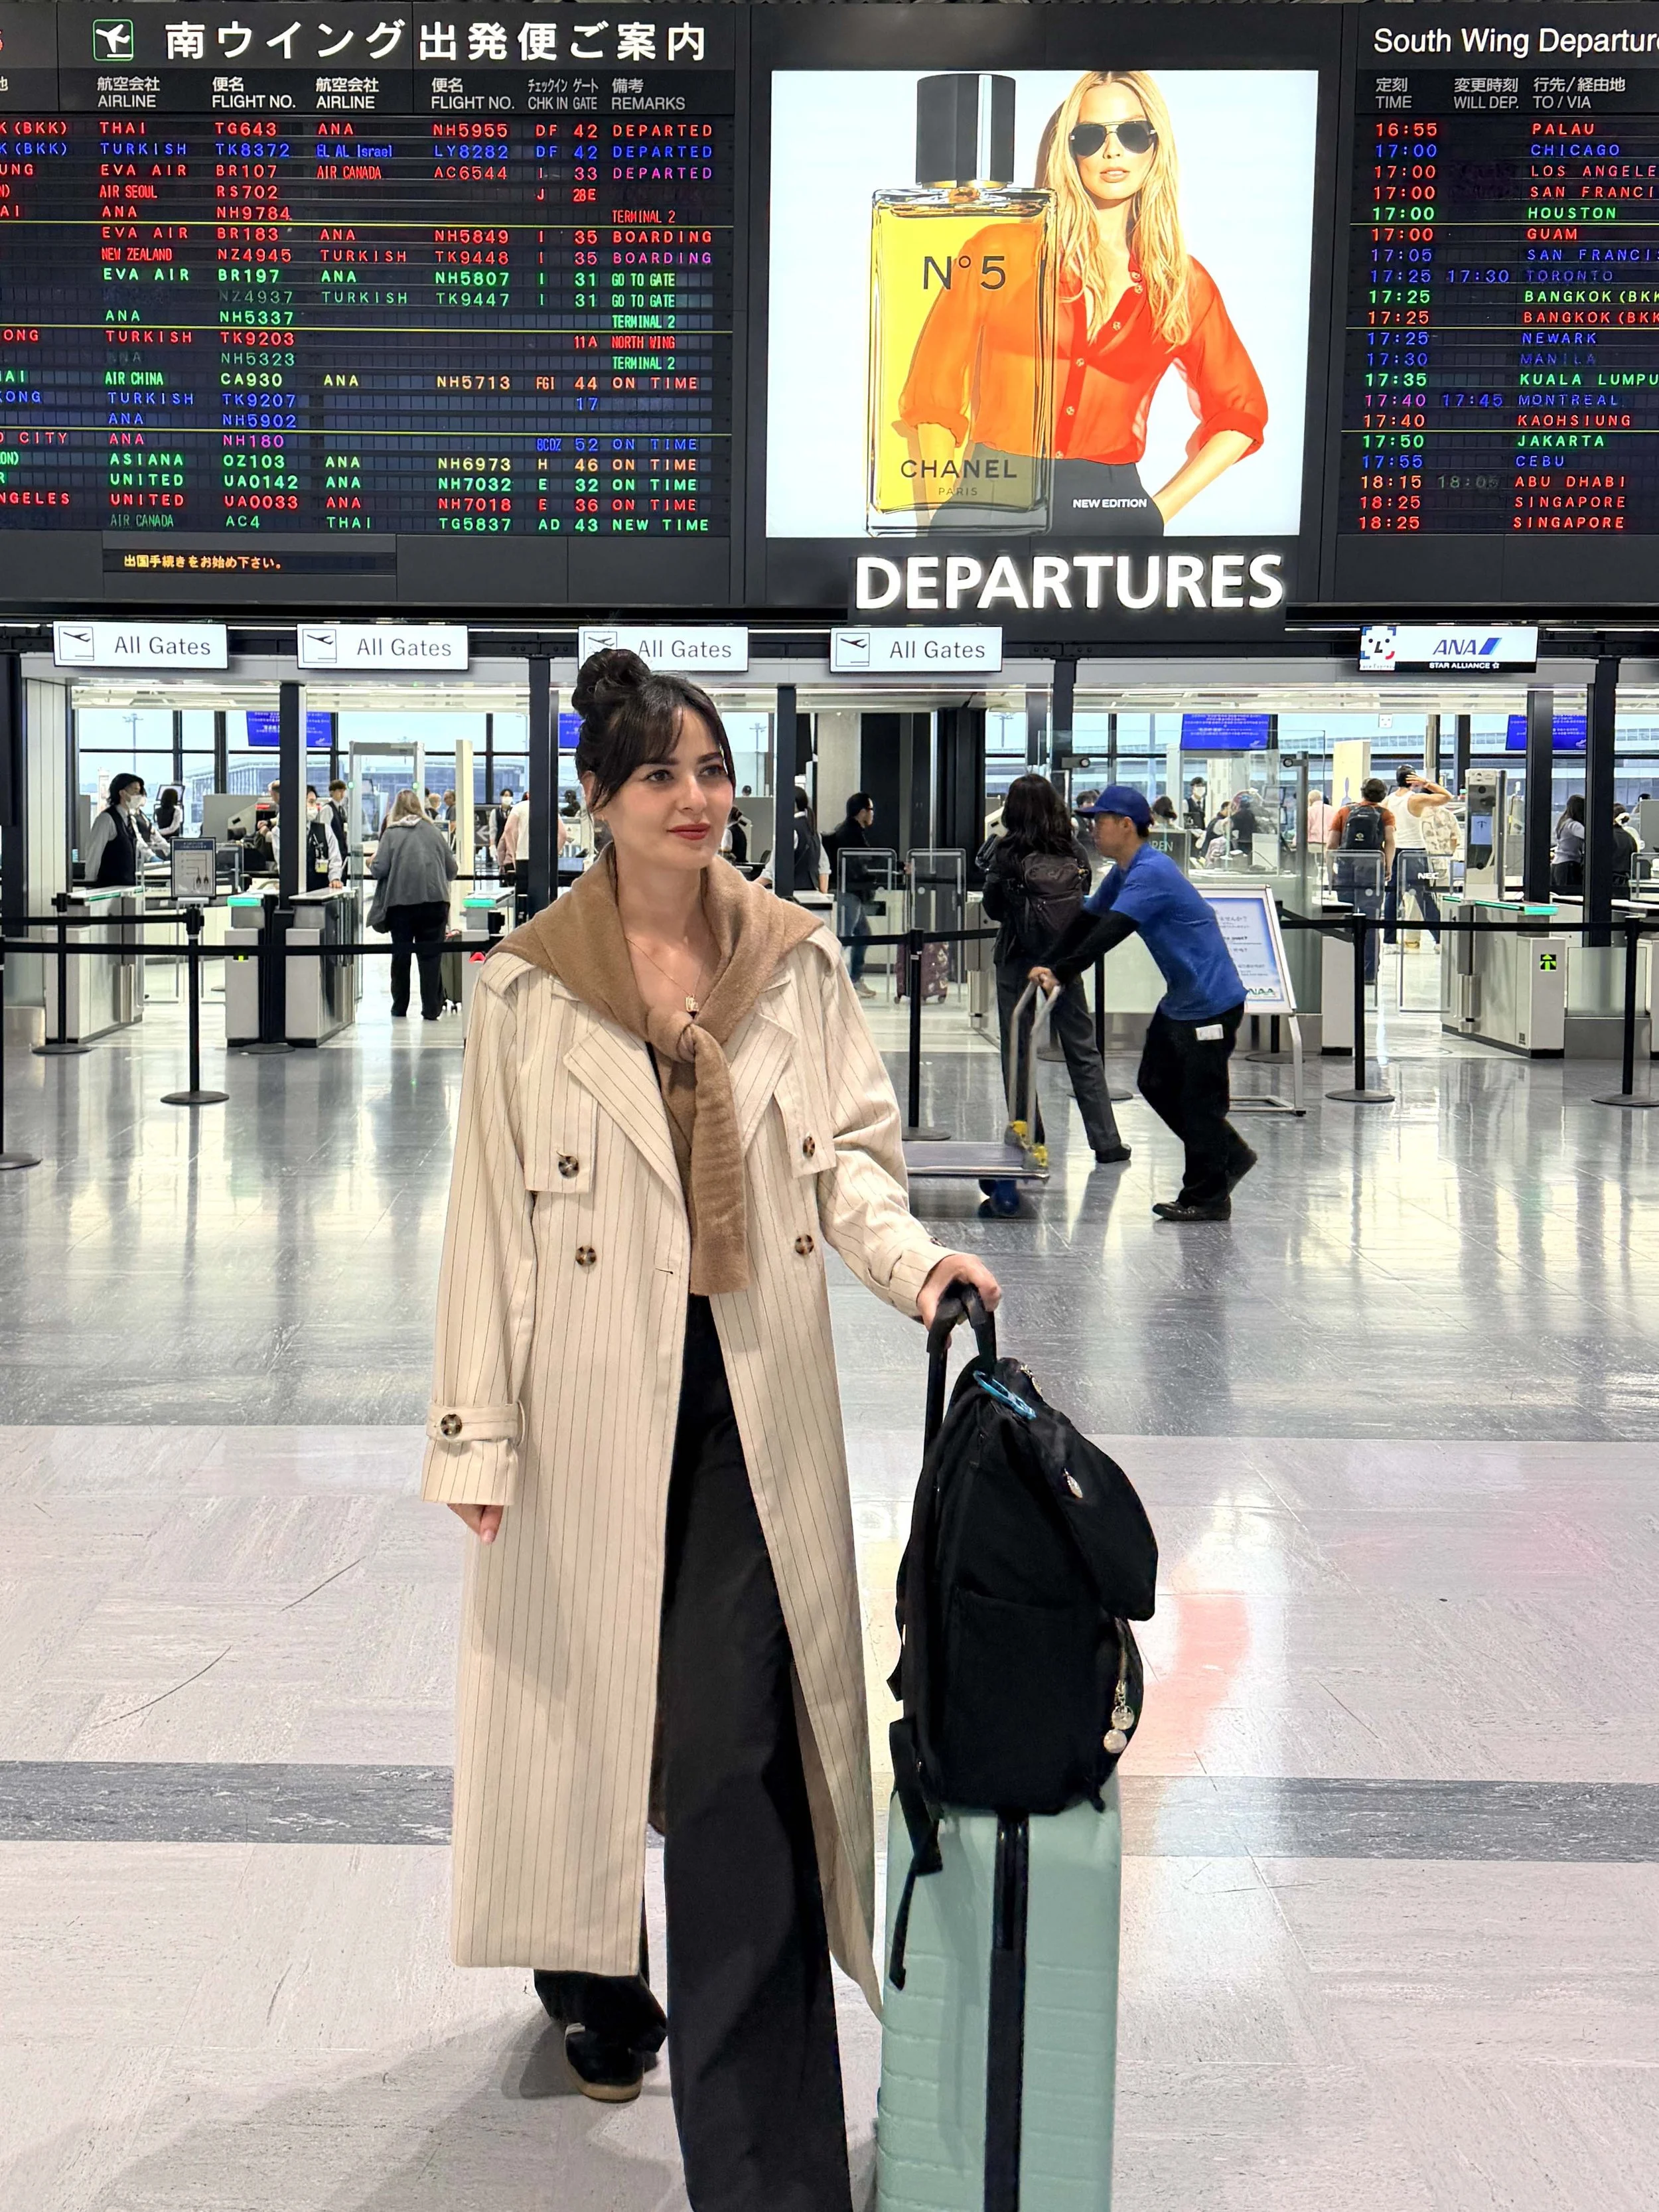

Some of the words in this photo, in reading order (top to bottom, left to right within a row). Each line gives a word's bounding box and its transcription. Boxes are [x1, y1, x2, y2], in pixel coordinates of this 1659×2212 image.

[166, 19, 704, 60] 南ウイング出発便ご案内
[1374, 29, 1451, 52] South
[1461, 29, 1529, 58] Wing
[1540, 29, 1659, 58] Departur
[98, 76, 160, 91] 航空会社
[213, 76, 244, 92] 便名
[316, 77, 379, 92] 航空会社
[432, 78, 463, 92] 便名
[528, 78, 567, 92] チェックイン
[573, 78, 598, 93] ゲート
[613, 78, 644, 93] 備考
[1376, 77, 1407, 92] 定刻
[1455, 78, 1518, 92] 変更時刻
[98, 95, 156, 107] AIRLINE
[212, 95, 265, 108] FLIGHT
[270, 95, 295, 108] NO.
[317, 96, 374, 108] AIRLINE
[432, 96, 484, 109] FLIGHT
[489, 96, 514, 109] NO.
[528, 97, 553, 110] CHK
[557, 97, 567, 109] IN
[573, 97, 597, 110] GATE
[612, 97, 685, 110] REMARKS
[1376, 96, 1411, 108] TIME
[1454, 96, 1486, 108] WILL
[1490, 96, 1519, 108] DEP.
[1533, 96, 1553, 108] TO
[1567, 96, 1591, 108] VIA
[15, 122, 66, 134] (BKK)
[100, 122, 144, 133] THAI
[215, 123, 276, 136] TG643
[319, 123, 353, 135] ANA
[433, 123, 507, 137] NH5955
[613, 125, 711, 136] DEPARTED
[1376, 123, 1437, 136] 16:55
[1533, 123, 1593, 135] PALAU
[101, 143, 185, 155] TURKISH
[216, 143, 289, 157] TK8372
[317, 144, 329, 157] EL
[336, 145, 349, 157] AL
[358, 145, 392, 157] Israel
[435, 145, 508, 159] LY8282
[1376, 144, 1437, 157] 17:00
[1532, 145, 1619, 155] CHICAGO
[101, 165, 135, 175] EVA
[153, 165, 185, 175] AIR
[216, 165, 276, 178] BR107
[316, 166, 336, 179] AIR
[343, 166, 381, 179] CANADA
[435, 167, 506, 180] AC6544
[1532, 165, 1565, 177] LOS
[1583, 166, 1656, 177] ANGELE
[100, 185, 119, 198] AIR
[125, 185, 157, 198] SEOUL
[217, 186, 277, 199] RS702
[573, 188, 595, 202] 28E
[217, 206, 290, 220] NH9784
[613, 210, 662, 222] TERMINAL
[669, 210, 675, 223] 2
[1528, 208, 1615, 218] HOUSTON
[218, 228, 277, 241] BR183
[435, 230, 508, 244] NH5849
[613, 231, 711, 243] BOARDING
[1528, 228, 1577, 240] GUAM
[102, 248, 120, 260] NEW
[127, 248, 172, 261] ZEALAND
[218, 249, 291, 262] NZ4945
[435, 251, 508, 265] TK9448
[1372, 249, 1431, 261] 17:05
[1528, 250, 1561, 260] SAN
[219, 269, 279, 283] BR197
[436, 271, 508, 285] NH5807
[612, 273, 624, 286] GO
[631, 273, 644, 286] TO
[650, 273, 674, 286] GATE
[1372, 269, 1431, 283] 17:25
[1449, 270, 1509, 283] 17:30
[1528, 270, 1612, 281] TORONTO
[219, 291, 292, 304] NZ4937
[437, 293, 508, 306] TK9447
[1525, 291, 1611, 302] BANGKOK
[220, 311, 293, 325] NH5337
[221, 332, 293, 345] TK9203
[575, 336, 597, 348] 11A
[612, 336, 644, 348] NORTH
[650, 336, 675, 349] WING
[1522, 332, 1595, 343] NEWARK
[222, 353, 294, 366] NH5323
[1521, 354, 1595, 364] MANILA
[106, 372, 125, 384] AIR
[131, 372, 163, 385] CHINA
[221, 373, 281, 387] CA930
[437, 376, 510, 389] NH5713
[537, 377, 553, 390] FGI
[613, 377, 634, 388] ON
[651, 378, 697, 389] TIME
[1366, 373, 1426, 386] 17:35
[222, 394, 295, 407] TK9207
[1366, 394, 1425, 406] 17:40
[1443, 394, 1502, 407] 17:45
[1519, 394, 1617, 406] MONTREAL
[223, 414, 296, 428] NH5902
[1518, 415, 1630, 426] KAOHSIUNG
[20, 432, 66, 443] CITY
[224, 435, 283, 447] NH180
[1364, 435, 1423, 447] 17:50
[1518, 435, 1603, 446] JAKARTA
[110, 453, 182, 465] ASIANA
[224, 455, 284, 469] OZ103
[439, 458, 510, 471] NH6973
[1363, 455, 1422, 468] 17:55
[1516, 456, 1563, 467] CEBU
[901, 459, 1017, 479] CHANEL
[111, 474, 182, 486] UNITED
[225, 475, 297, 488] UA0142
[439, 478, 510, 491] NH7032
[1362, 476, 1421, 488] 18:15
[1515, 477, 1550, 486] ABU
[1567, 477, 1624, 487] DHABI
[938, 486, 977, 496] PARIS
[225, 495, 297, 509] UA0033
[439, 498, 510, 511] NH7018
[1073, 499, 1100, 508] NEW
[1102, 499, 1147, 508] EDITION
[1361, 496, 1420, 509] 18:25
[1516, 496, 1624, 508] SINGAPORE
[226, 516, 259, 528] AC4
[439, 518, 510, 531] TG5837
[613, 520, 648, 530] NEW
[663, 520, 707, 530] TIME
[856, 555, 1283, 609] DEPARTURES
[115, 636, 139, 653] All
[149, 637, 210, 654] Gates
[358, 638, 382, 655] All
[392, 639, 451, 656] Gates
[639, 640, 662, 657] All
[672, 640, 731, 657] Gates
[890, 641, 914, 658] All
[924, 641, 984, 658] Gates
[1433, 640, 1476, 654] ANA
[1149, 841, 1173, 851] PEN
